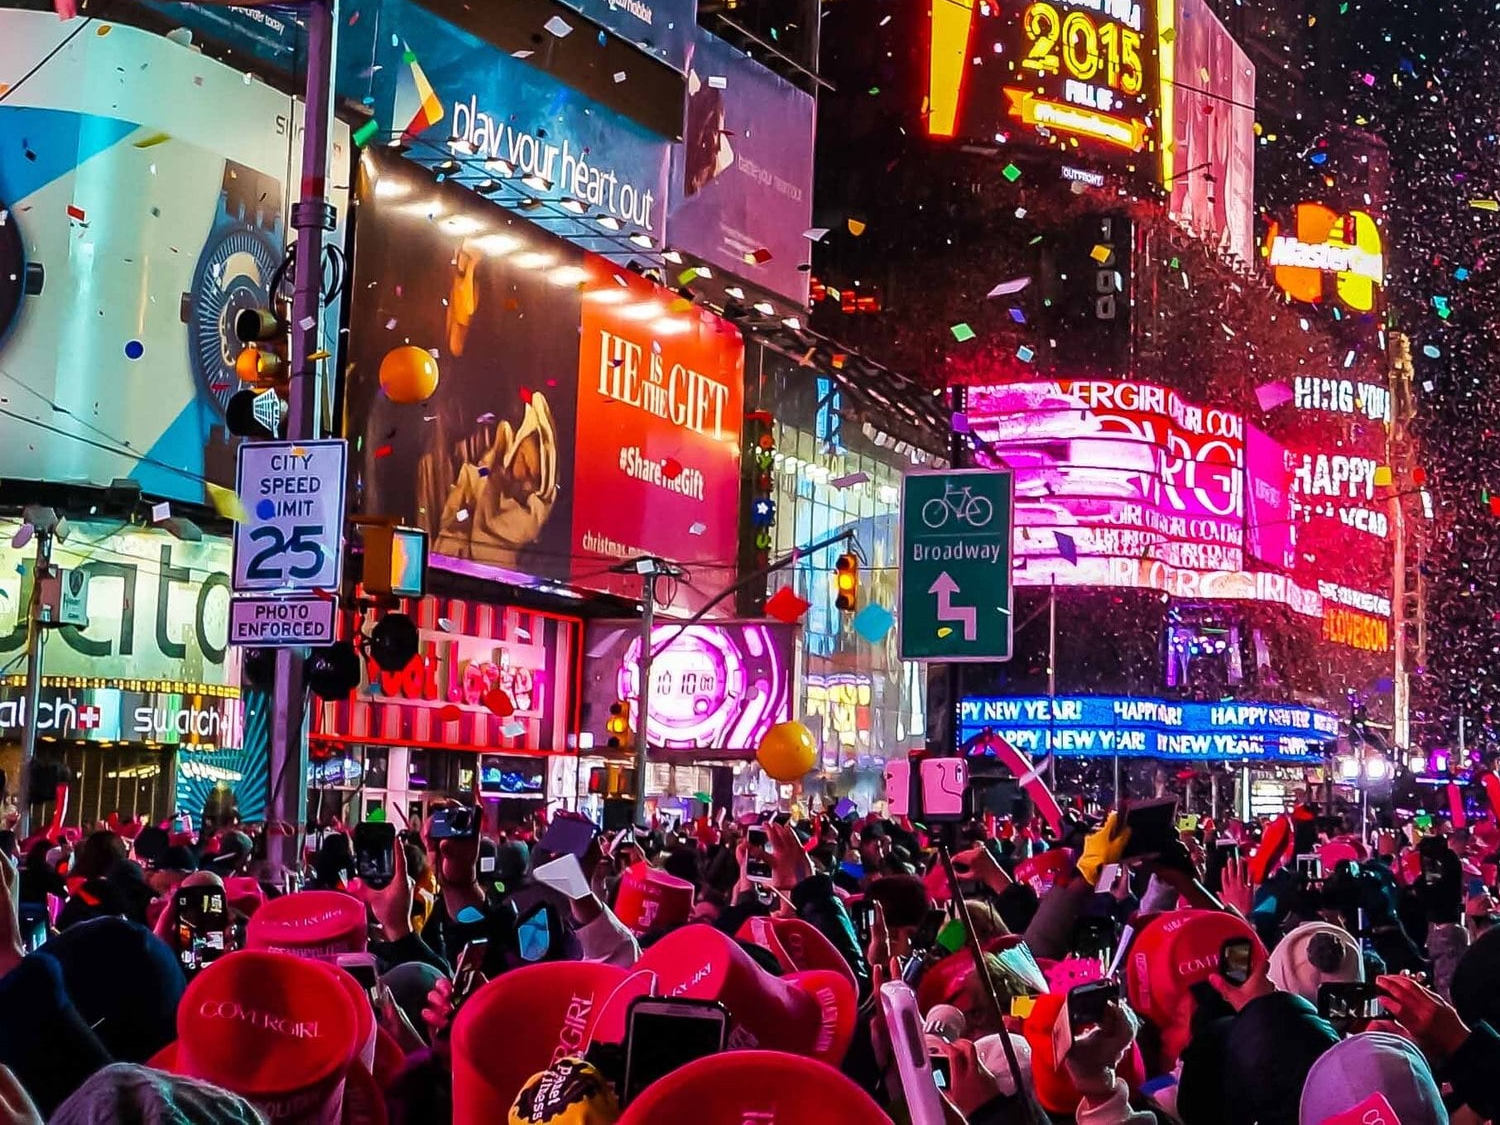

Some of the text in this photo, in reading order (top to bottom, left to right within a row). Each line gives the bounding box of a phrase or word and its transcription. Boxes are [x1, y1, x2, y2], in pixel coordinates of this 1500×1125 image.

[1022, 1, 1143, 96] 2015
[452, 94, 655, 232] play your heart out
[597, 329, 729, 442] HE IS THE GIFT
[271, 453, 314, 472] CITY
[1293, 453, 1377, 501] HAPPY
[260, 476, 322, 496] SPEED
[262, 499, 314, 518] IMIT
[246, 525, 326, 580] 25
[913, 542, 1001, 565] Broadway
[255, 603, 310, 620] PHOTO
[238, 621, 325, 638] ENFORCED
[134, 706, 219, 737] swatch
[984, 701, 1021, 721] NEW
[1024, 700, 1083, 721] YEAR!
[1211, 706, 1268, 726] HAPPY
[1045, 730, 1098, 750] NEW
[1168, 734, 1213, 754] NEW
[200, 1001, 322, 1038] COVERGIRL
[532, 1069, 554, 1121] fitness
[548, 1064, 573, 1107] planet
